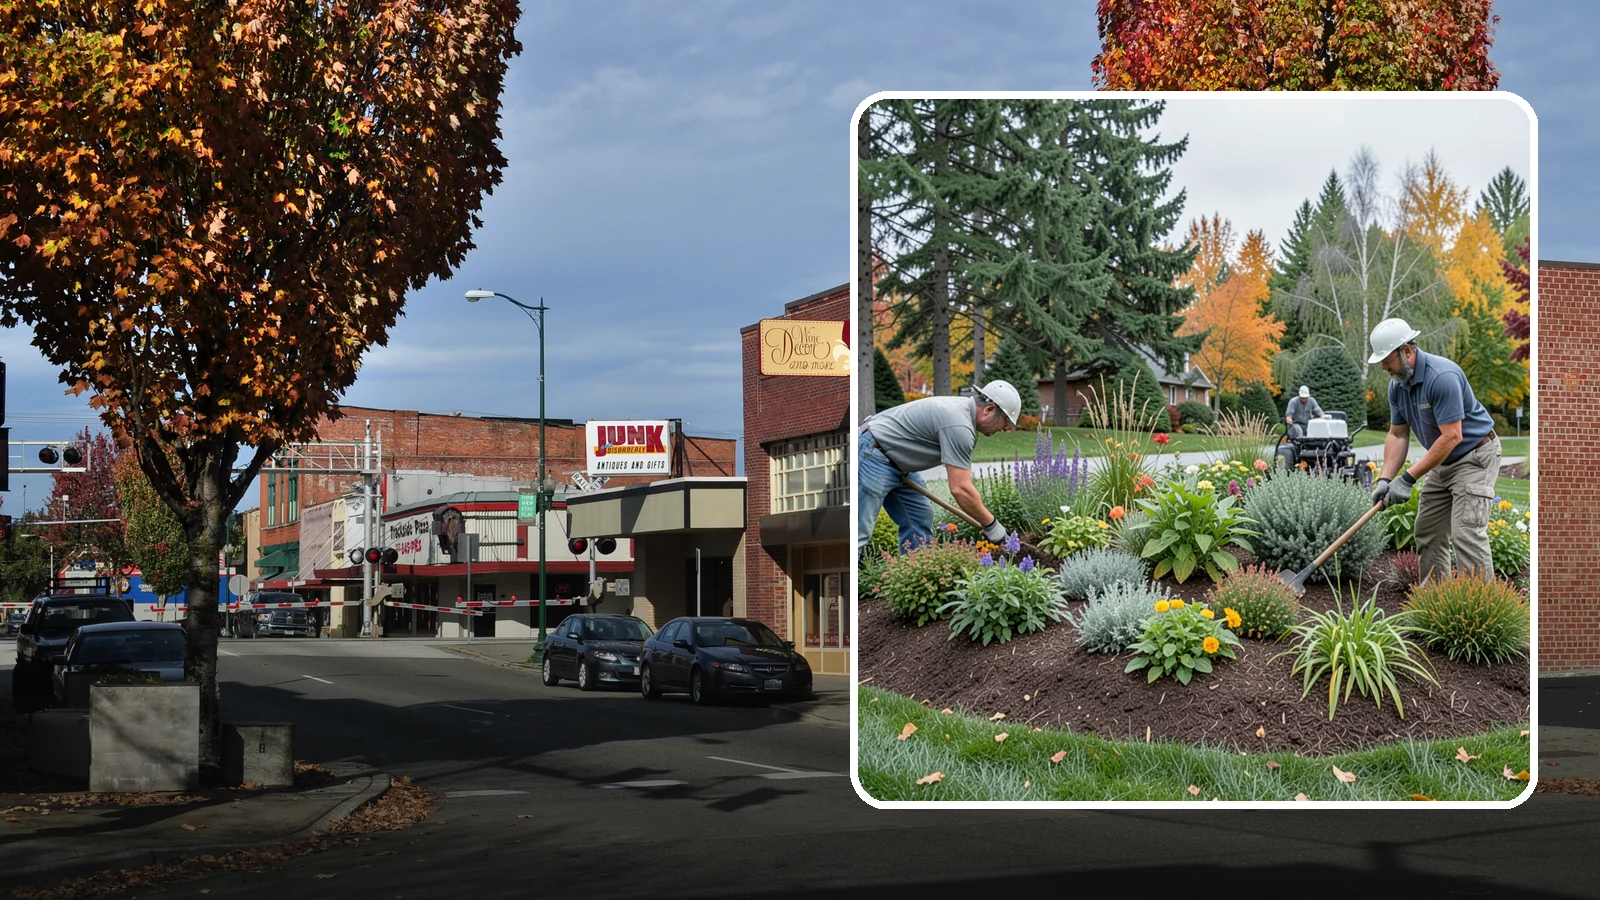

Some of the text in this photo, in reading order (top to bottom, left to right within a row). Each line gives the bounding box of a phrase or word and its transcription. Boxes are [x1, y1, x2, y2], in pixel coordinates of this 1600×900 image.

[765, 328, 831, 365] Decor
[596, 425, 665, 457] JUNK
[607, 446, 646, 454] DISORDERLY
[597, 460, 665, 470] ANTIQUES AND GIFTS
[414, 519, 429, 535] Pizza
